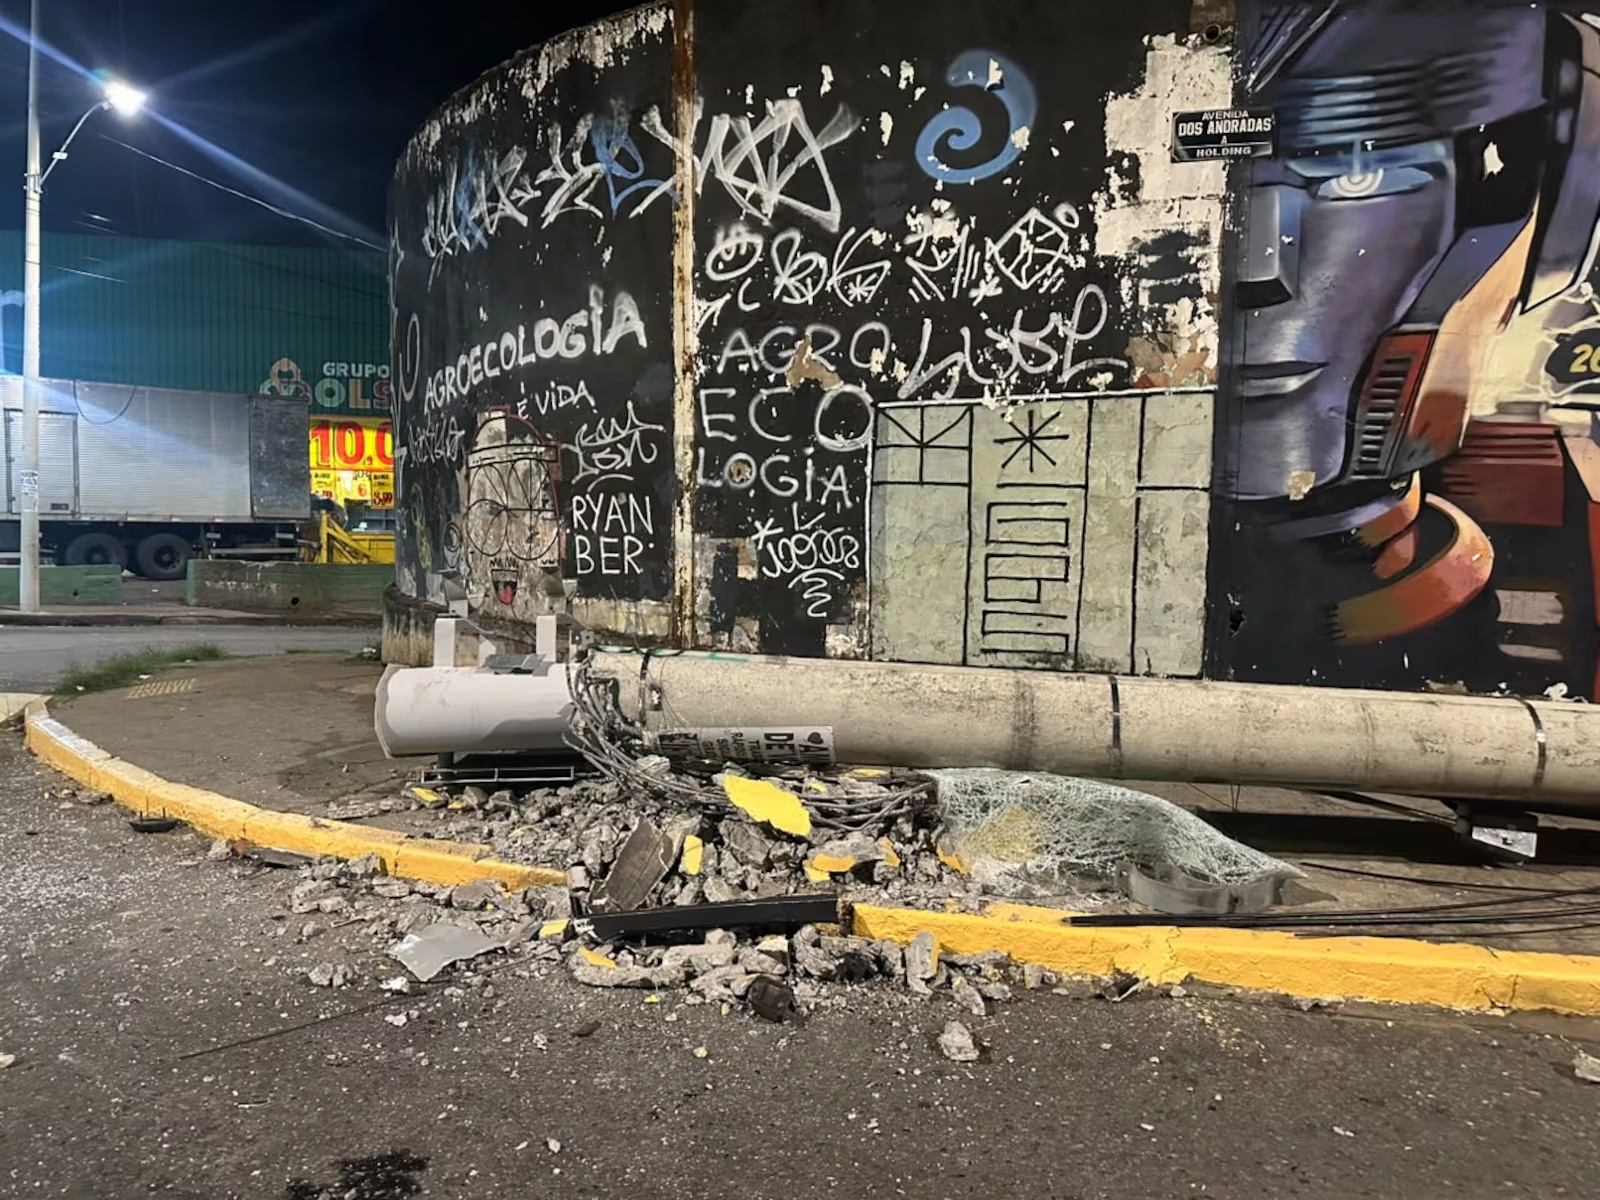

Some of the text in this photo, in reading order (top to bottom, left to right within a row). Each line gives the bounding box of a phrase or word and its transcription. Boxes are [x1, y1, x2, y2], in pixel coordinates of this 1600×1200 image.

[1201, 110, 1249, 120] AVENIDA
[1178, 118, 1272, 137] DOS ANDRADAS
[1220, 135, 1227, 145] A
[1196, 146, 1252, 157] HOLDING
[322, 361, 391, 379] GRUPO
[699, 383, 875, 451] ECO
[571, 492, 653, 535] RYAN
[575, 535, 644, 575] BER
